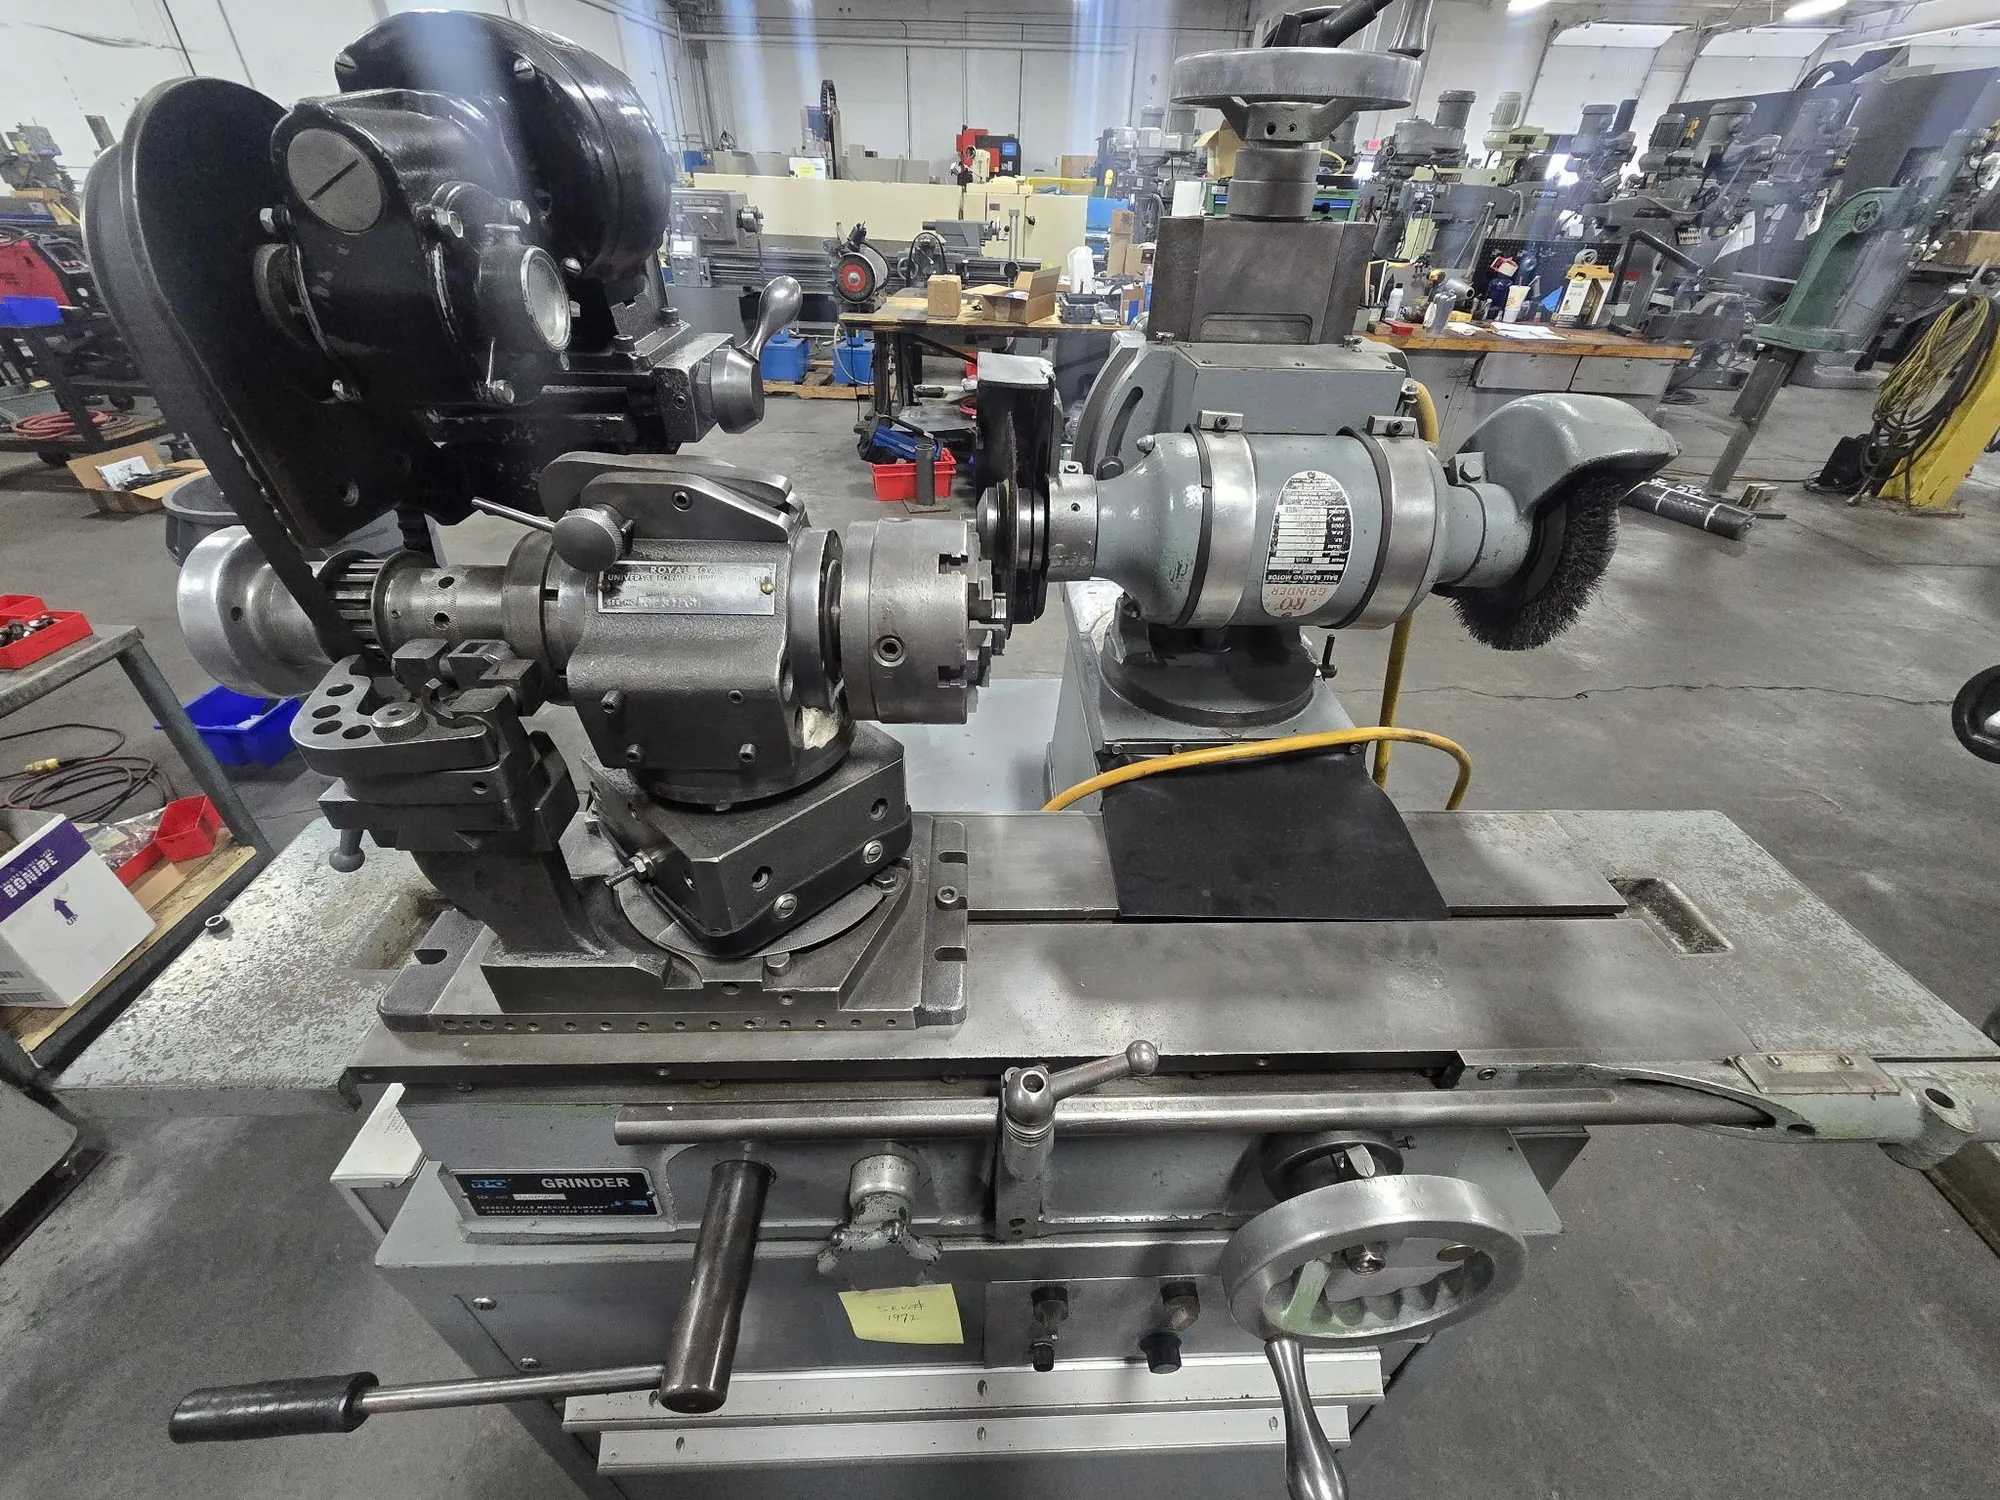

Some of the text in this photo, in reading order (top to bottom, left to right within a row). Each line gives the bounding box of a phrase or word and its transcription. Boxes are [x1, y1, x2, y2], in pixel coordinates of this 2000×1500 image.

[650, 566, 689, 575] ROYAL
[1271, 586, 1327, 596] GRINDER
[2, 853, 59, 899] BONIDE
[66, 913, 80, 927] UP
[541, 1177, 631, 1189] GRINDER
